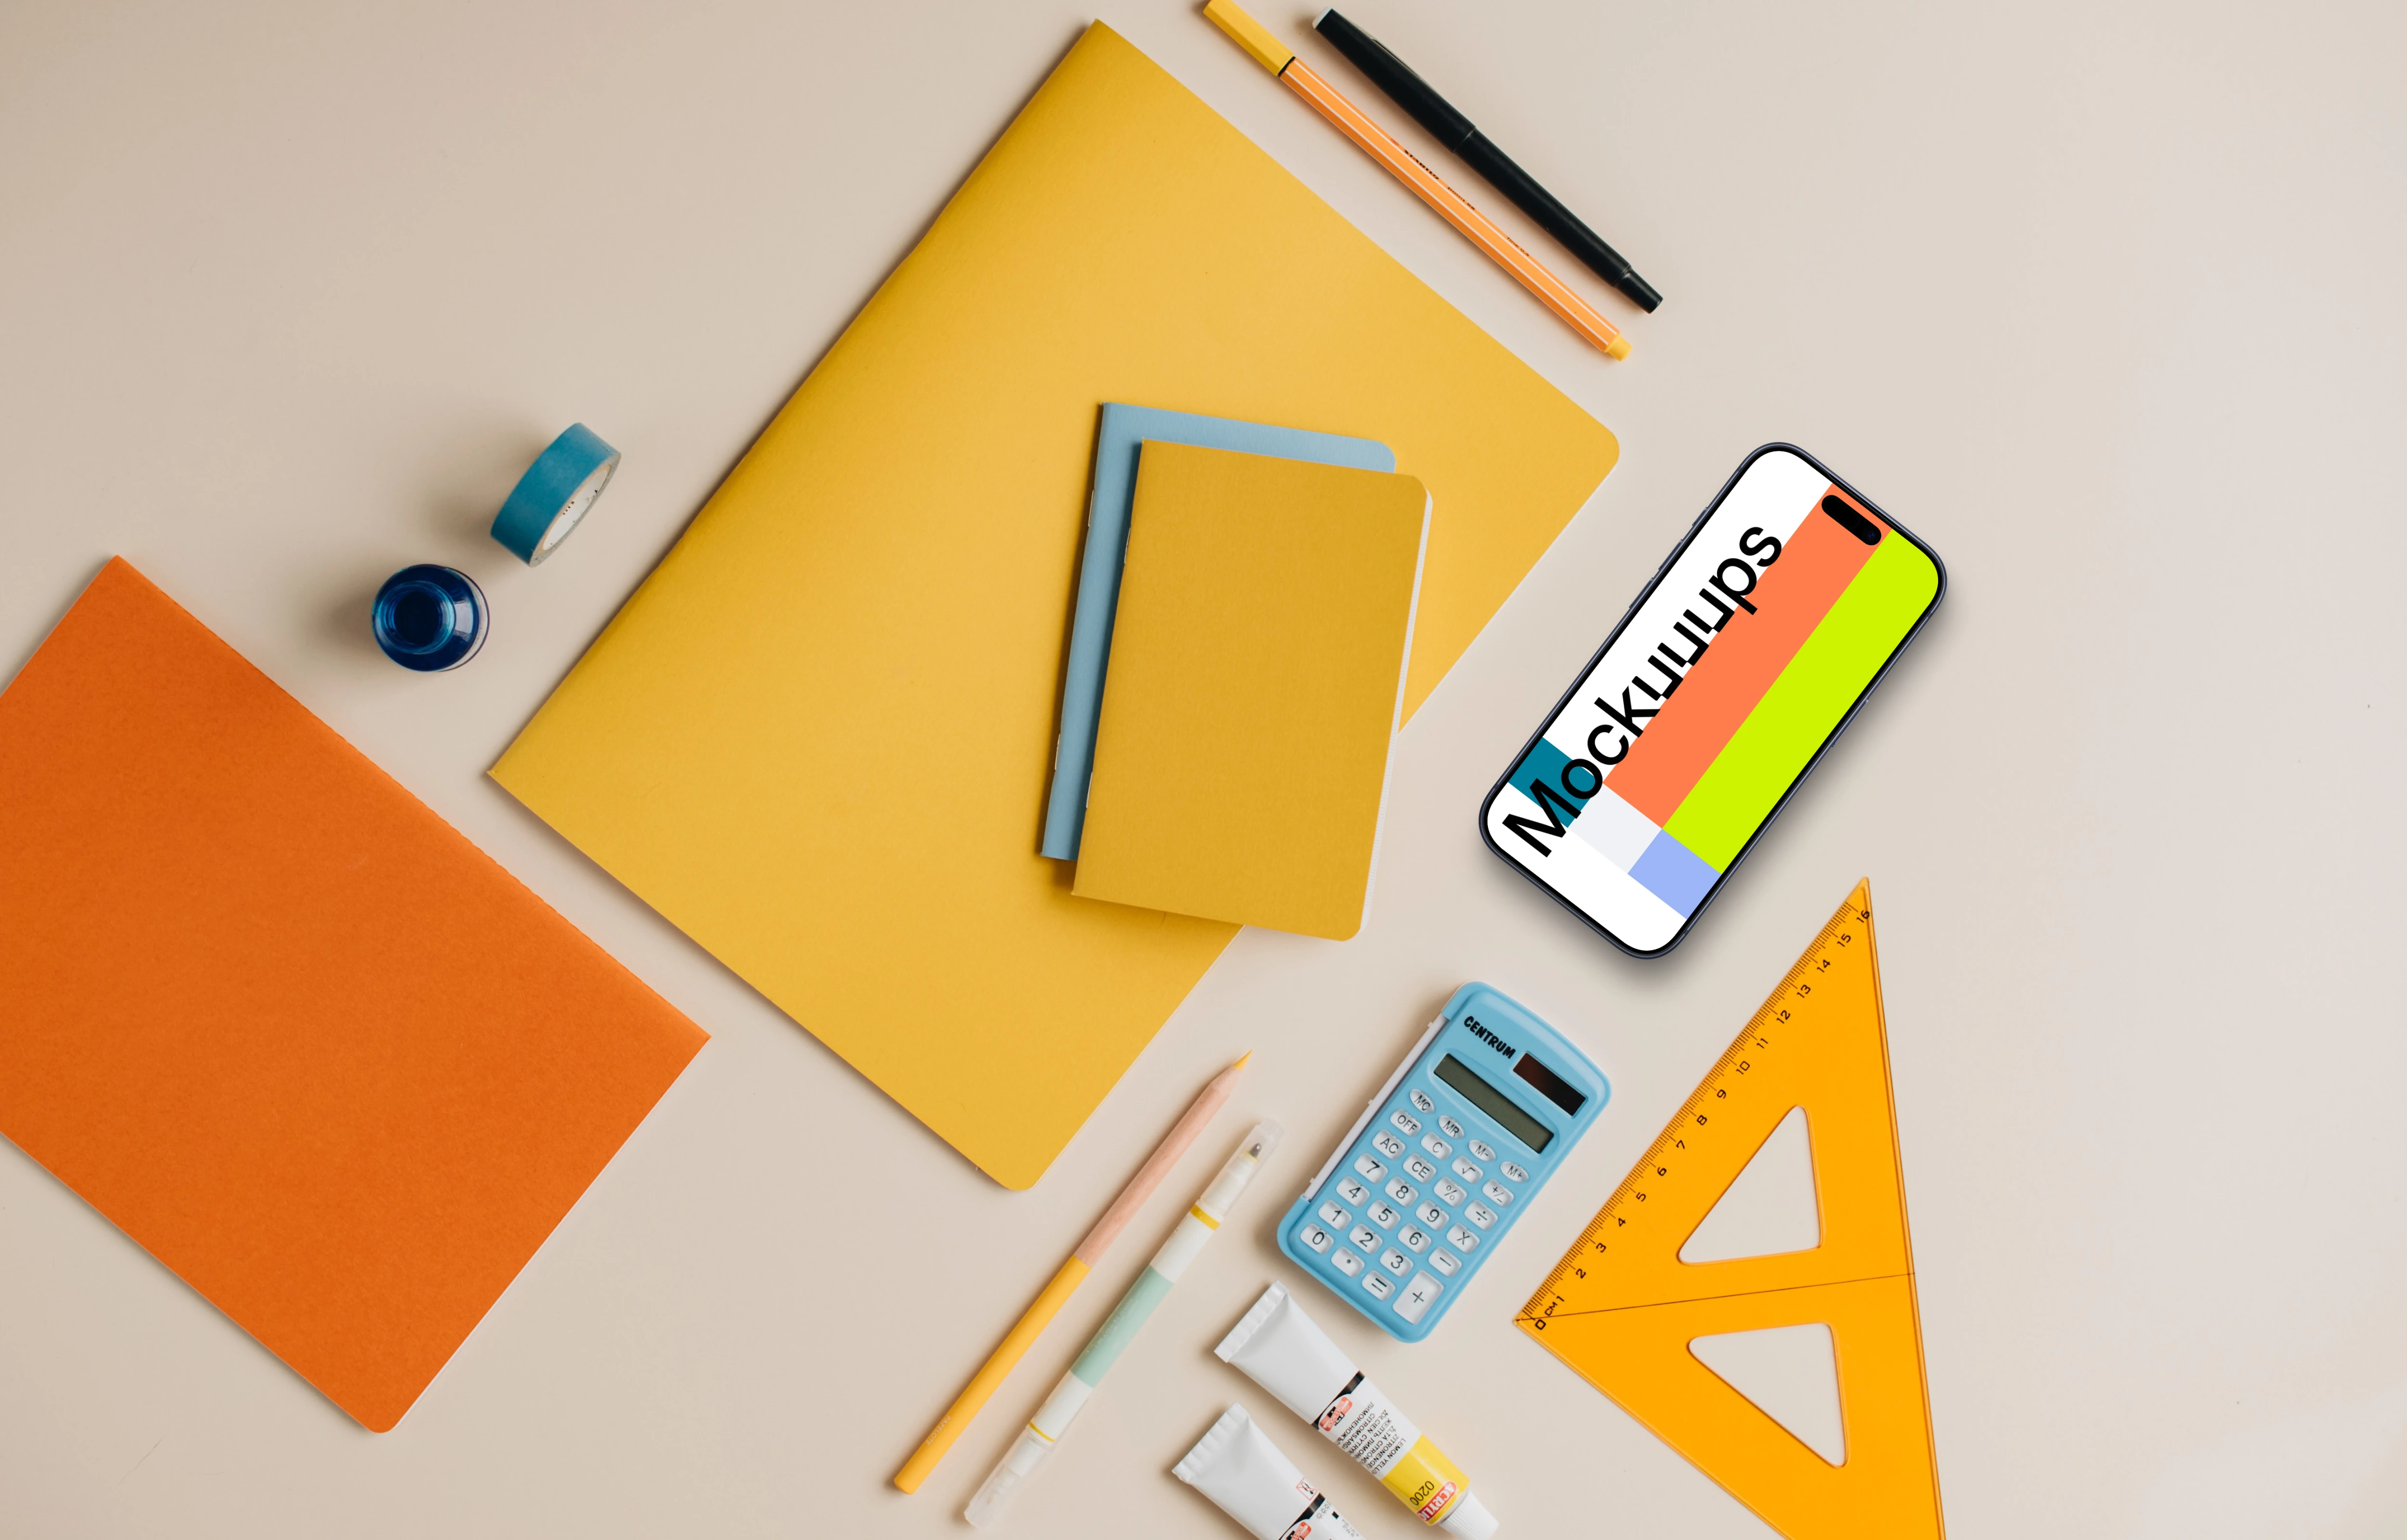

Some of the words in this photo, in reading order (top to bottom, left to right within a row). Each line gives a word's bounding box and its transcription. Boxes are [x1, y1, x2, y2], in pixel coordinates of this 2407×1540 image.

[1502, 526, 1782, 858] Mockuuups
[1464, 1016, 1515, 1059] CENTRUM
[1414, 1095, 1430, 1111] MC
[1397, 1115, 1417, 1131] OFF
[1535, 1319, 1546, 1330] 0
[1576, 1269, 1586, 1279] 2
[1596, 1243, 1606, 1253] 3
[1618, 1218, 1626, 1228] 4
[1636, 1193, 1646, 1201] 5
[1657, 1167, 1667, 1176] 6
[1676, 1140, 1685, 1149] 7
[1697, 1115, 1707, 1125] 8
[1717, 1090, 1726, 1098] 9
[1736, 1061, 1750, 1074] 10
[1757, 1038, 1768, 1048] 11
[1777, 1010, 1790, 1024] 12
[1797, 985, 1811, 998] 13
[1817, 960, 1830, 972] 14
[1837, 934, 1851, 947] 15
[1857, 911, 1869, 923] 16
[1443, 1121, 1460, 1137] MR
[1380, 1138, 1398, 1153] AC
[1433, 1142, 1442, 1152] C
[1367, 1161, 1380, 1173] 7
[1412, 1162, 1429, 1178] CE
[1507, 1166, 1522, 1178] M+
[1349, 1187, 1361, 1198] 4
[1397, 1186, 1409, 1198] 8
[1333, 1210, 1342, 1221] 1
[1379, 1208, 1392, 1221] 5
[1427, 1209, 1439, 1221] 9
[1313, 1232, 1324, 1245] 0
[1359, 1232, 1373, 1247] 2
[1410, 1232, 1422, 1245] 6
[1391, 1255, 1403, 1269] 3
[926, 1415, 951, 1446] PAPELOTE
[1347, 1434, 1367, 1454] CYTRYN
[1367, 1434, 1399, 1468] ZITRONENGE
[1387, 1438, 1406, 1459] LEMON
[1372, 1458, 1389, 1475] YELLO
[1410, 1481, 1434, 1505] 0200
[1418, 1483, 1454, 1521] ACRYLIC
